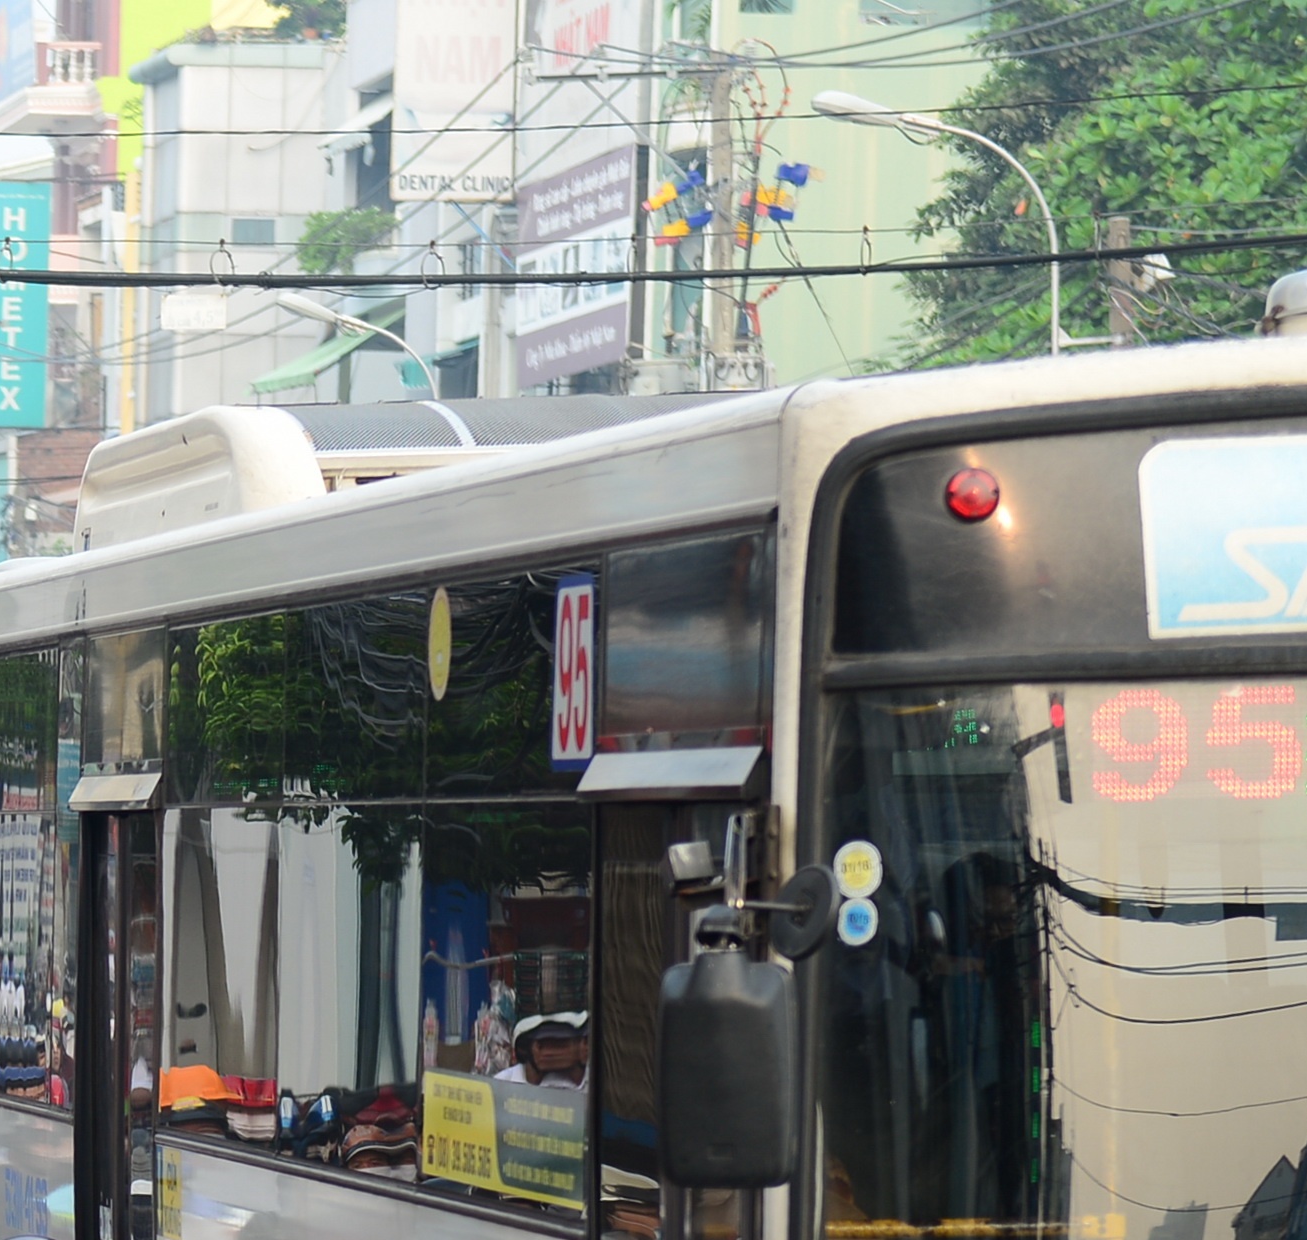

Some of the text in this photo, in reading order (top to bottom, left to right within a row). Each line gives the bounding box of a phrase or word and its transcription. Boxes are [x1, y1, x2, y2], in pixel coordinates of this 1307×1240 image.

[399, 174, 510, 192] DENTAL CLINIC
[558, 594, 589, 752] 95
[1091, 686, 1301, 801] 95
